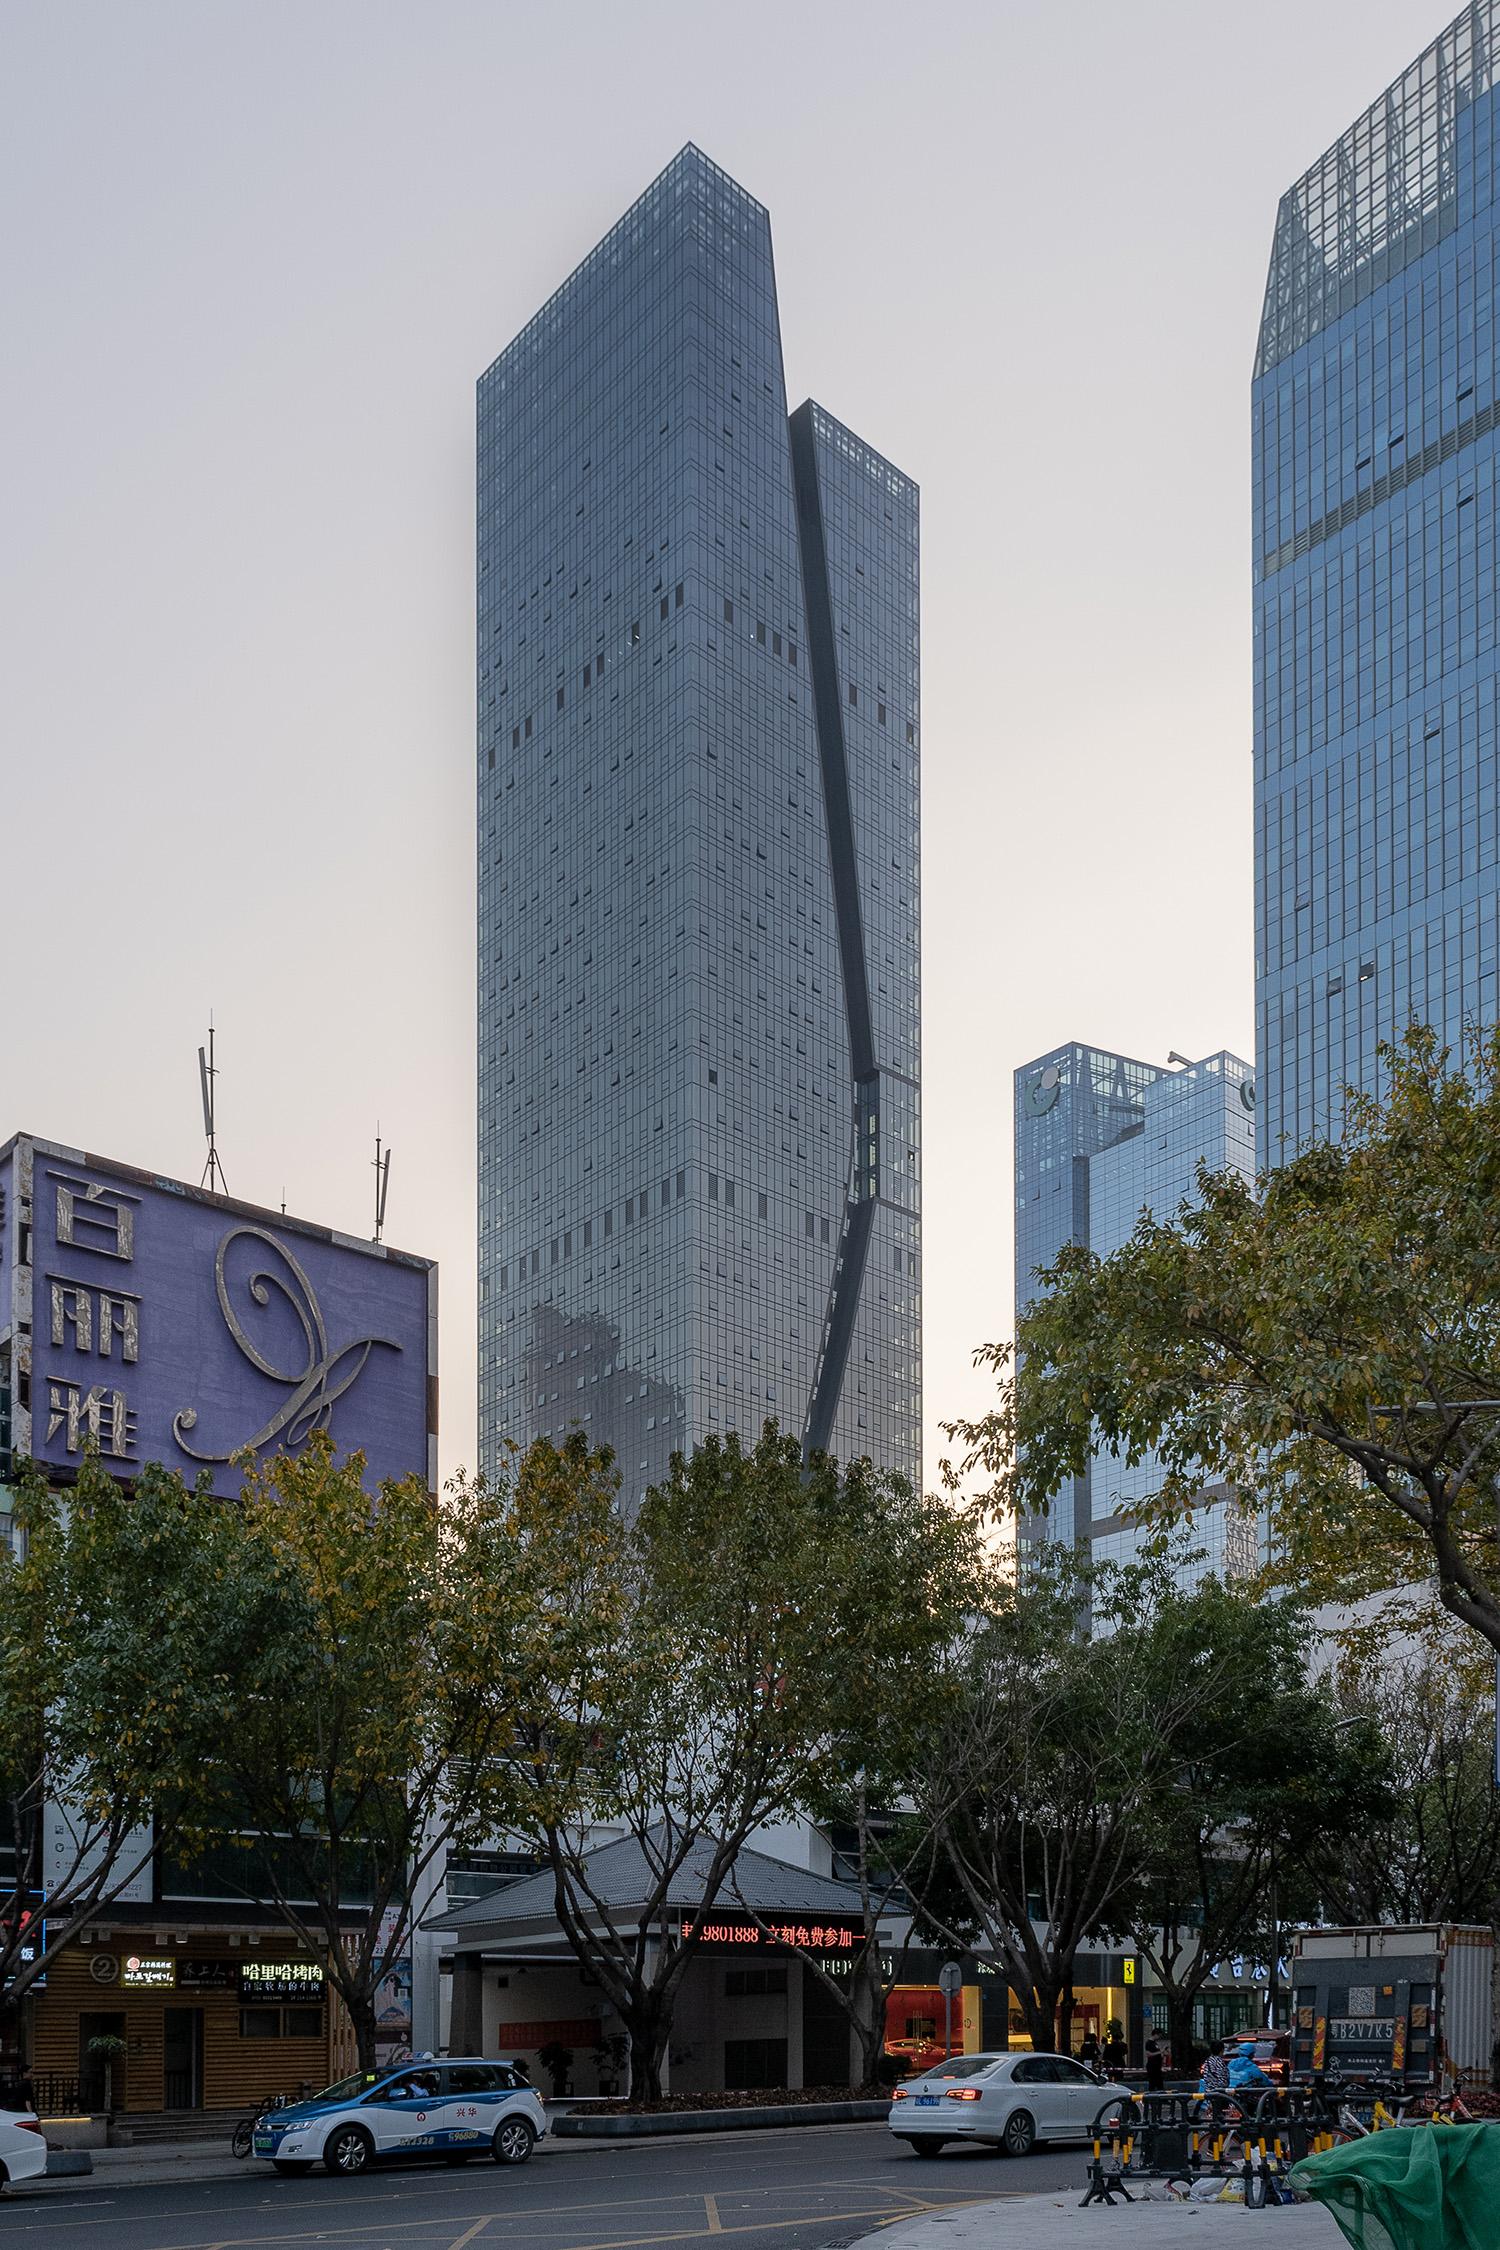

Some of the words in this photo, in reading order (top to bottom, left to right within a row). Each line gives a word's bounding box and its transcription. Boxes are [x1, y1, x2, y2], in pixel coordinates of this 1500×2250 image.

[696, 1925, 759, 1943] 9801888
[242, 1963, 323, 1981] 哈里哈烤肉
[456, 2107, 477, 2117] 兴华
